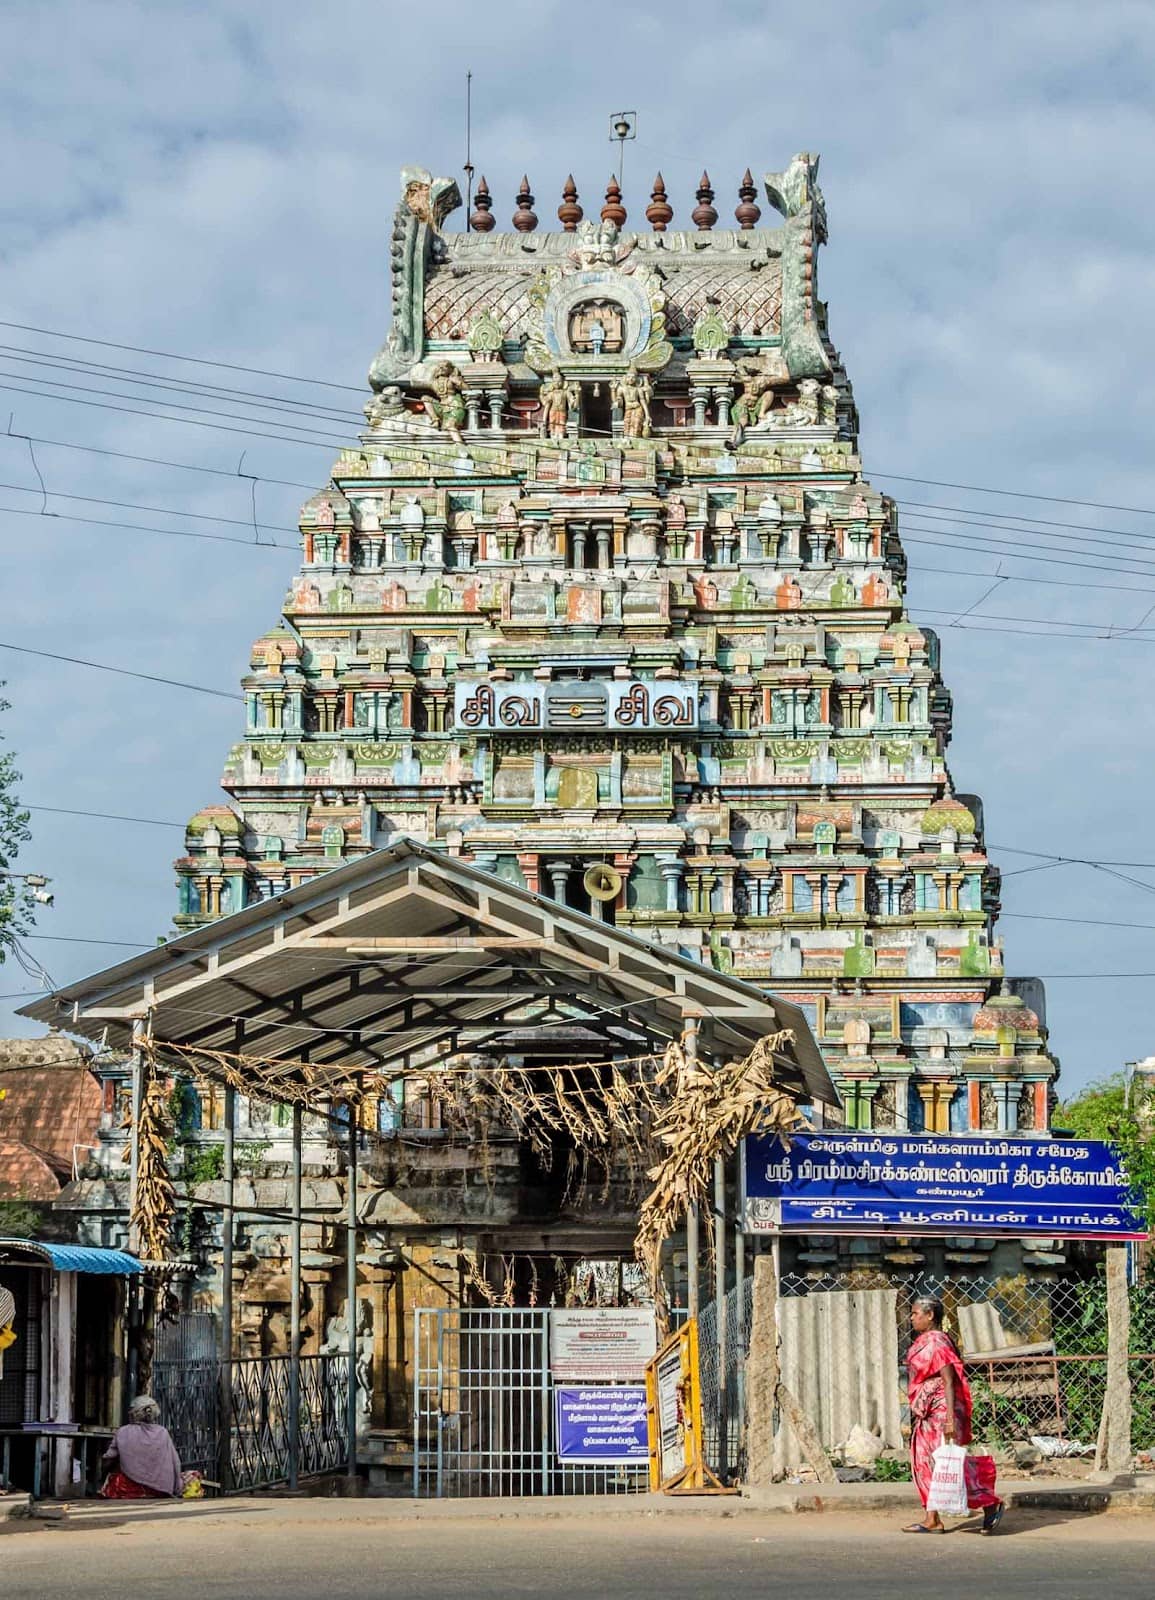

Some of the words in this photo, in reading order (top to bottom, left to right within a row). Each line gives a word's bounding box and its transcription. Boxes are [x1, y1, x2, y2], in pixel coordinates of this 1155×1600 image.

[460, 684, 541, 727] சிவ
[614, 683, 694, 726] சிவ
[808, 1137, 898, 1155] அருள்மிகு
[903, 1140, 1032, 1156] மங்களாம்பிகா
[1036, 1144, 1089, 1160] சமேத
[765, 1157, 793, 1182] ஸ்ரீ
[811, 1205, 889, 1221] சிட்டி
[900, 1209, 1028, 1224] யூனியன்
[1037, 1212, 1121, 1226] பாங்க்
